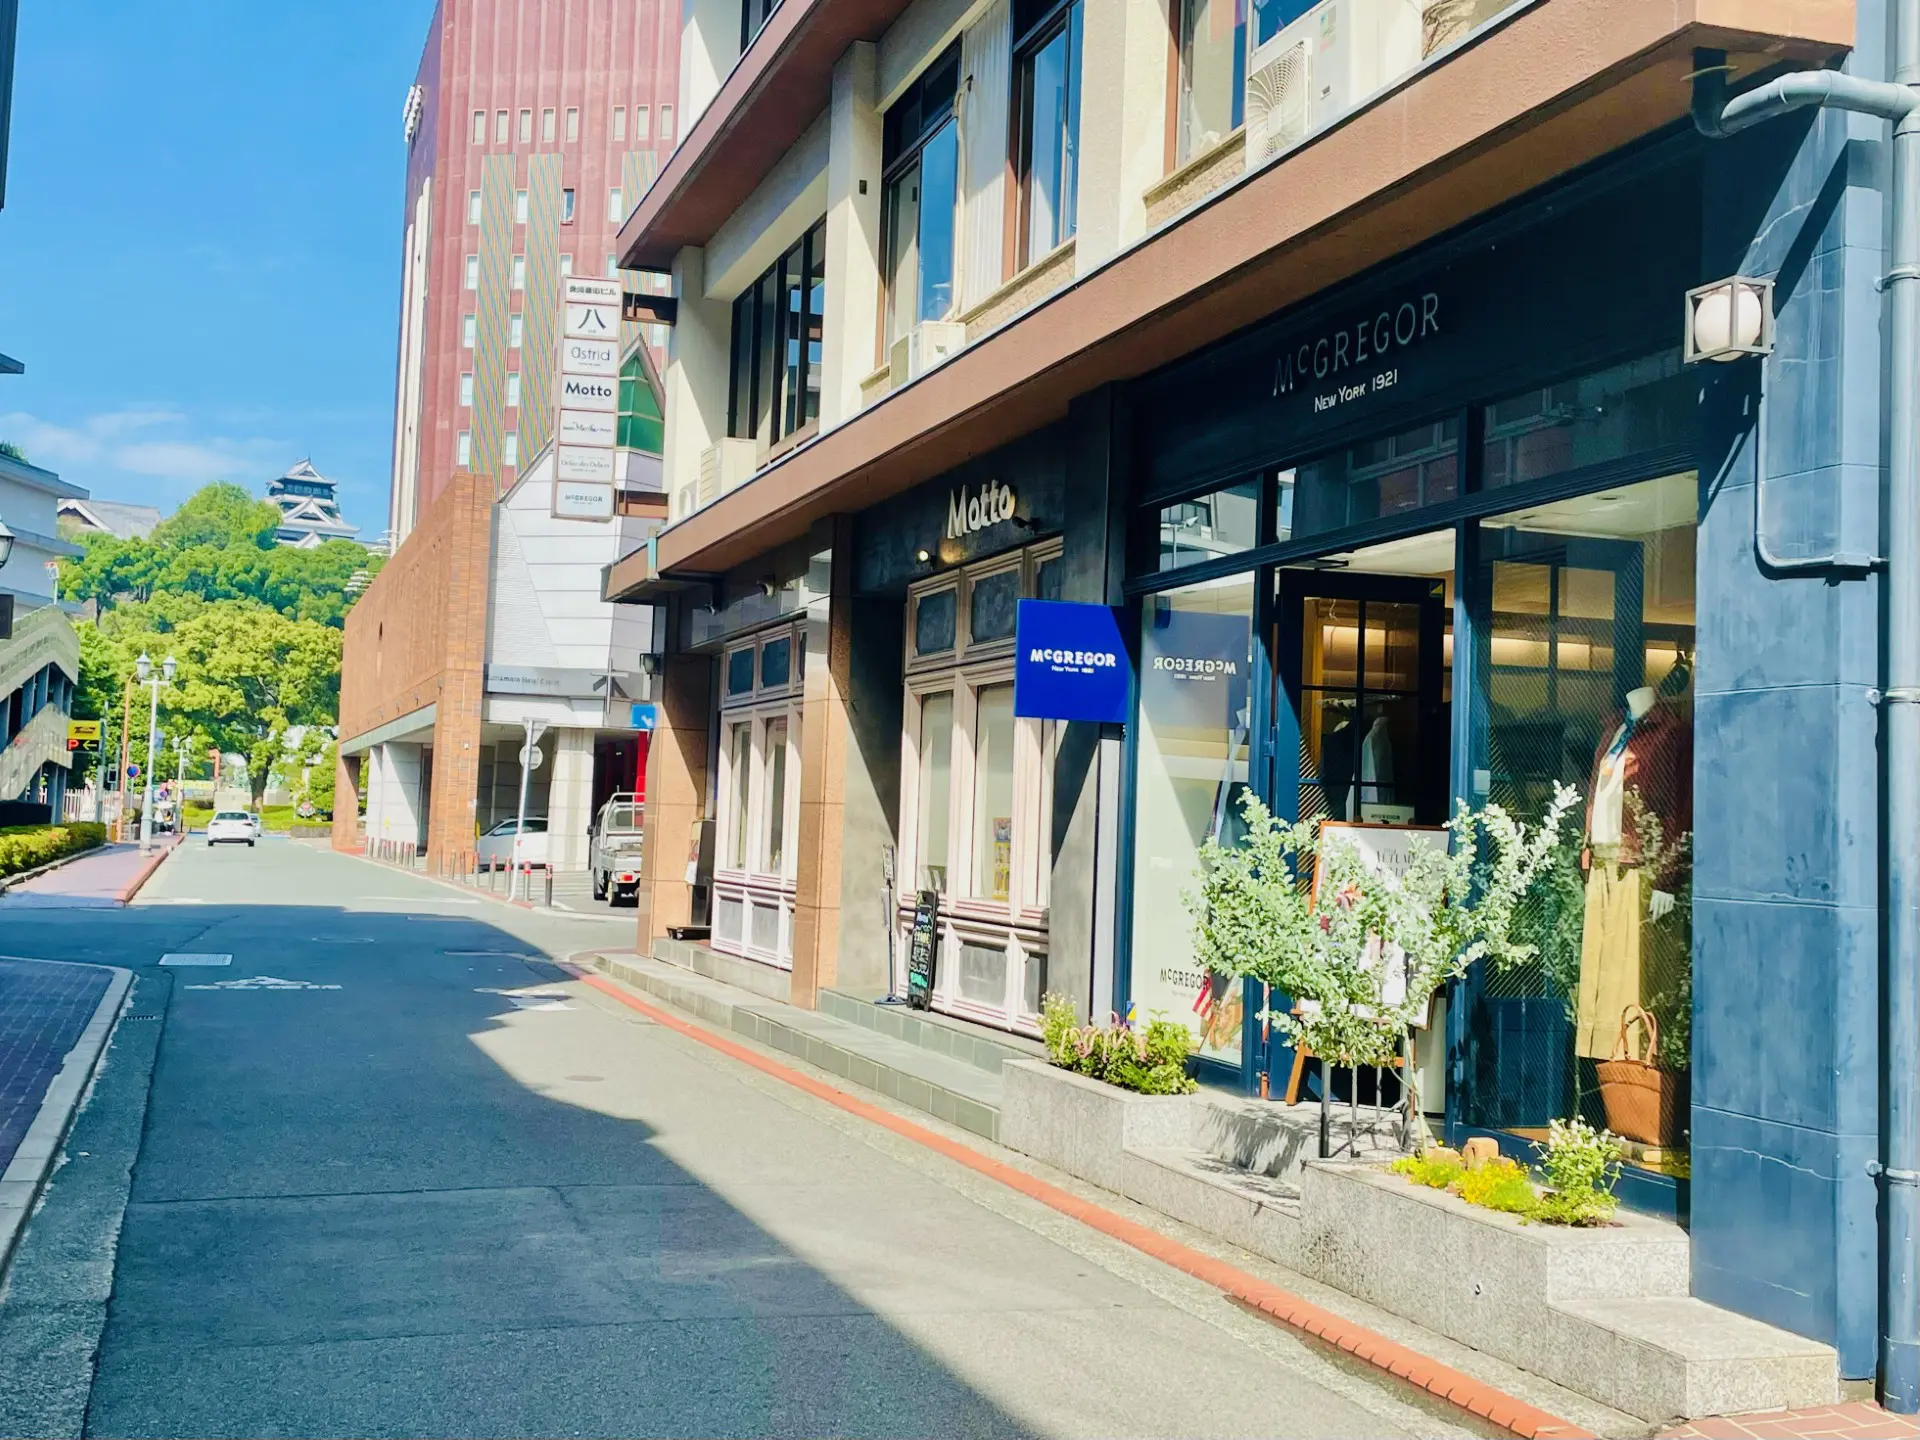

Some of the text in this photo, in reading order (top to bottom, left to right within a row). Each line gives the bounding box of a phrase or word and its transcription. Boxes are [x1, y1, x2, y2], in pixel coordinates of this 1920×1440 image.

[577, 309, 607, 330] 八
[565, 381, 612, 397] Motto
[1372, 369, 1398, 391] 1921
[947, 480, 1015, 538] Motto
[68, 740, 79, 751] P
